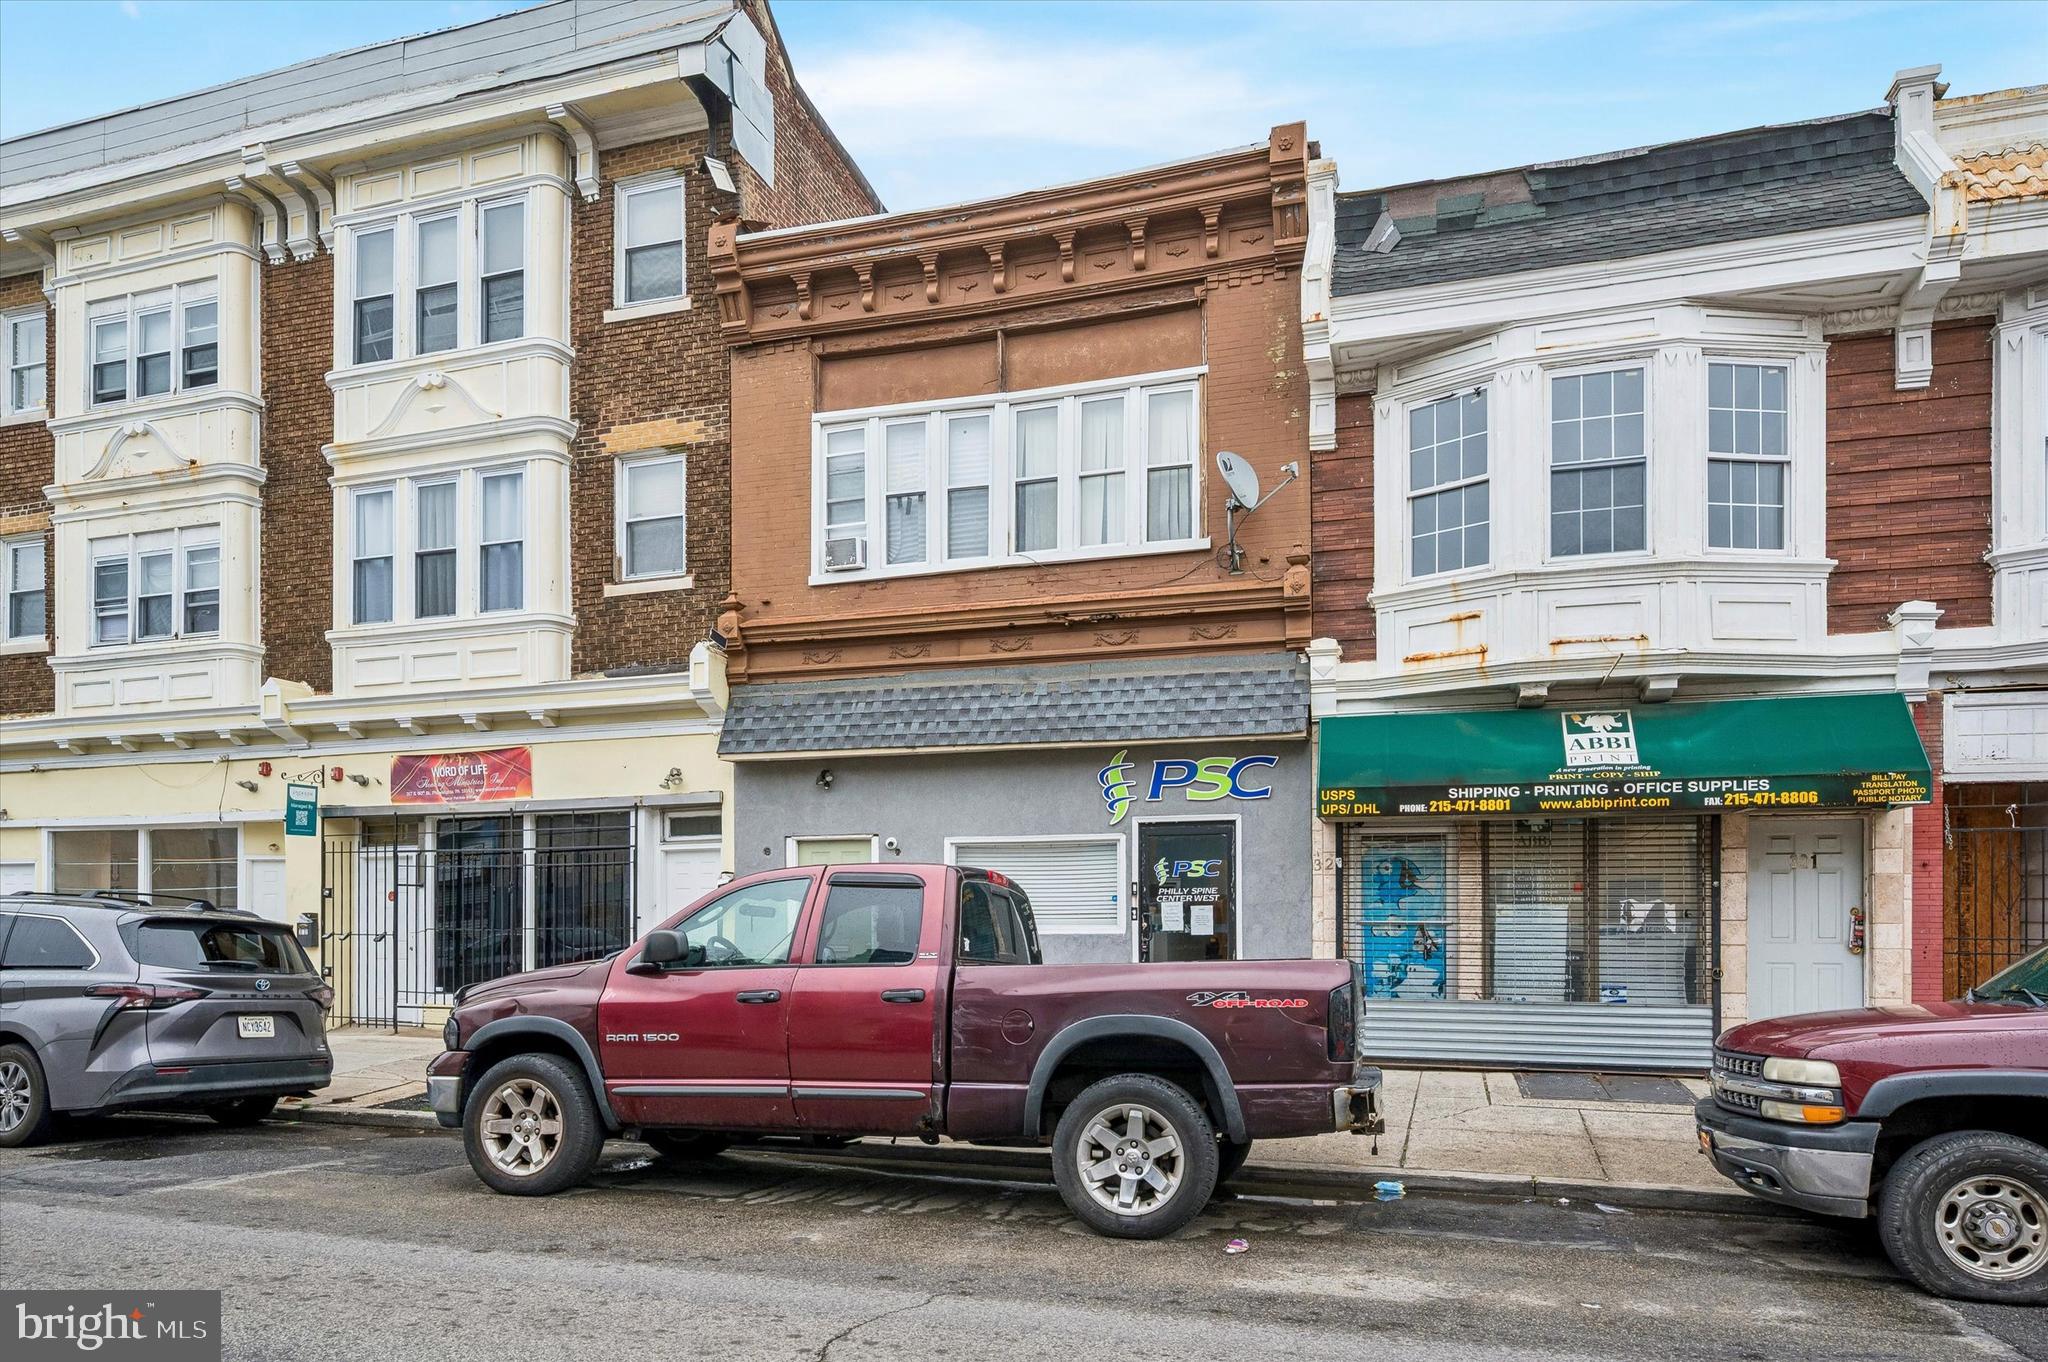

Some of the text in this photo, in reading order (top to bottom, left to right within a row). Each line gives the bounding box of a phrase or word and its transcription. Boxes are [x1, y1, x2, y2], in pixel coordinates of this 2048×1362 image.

[1569, 736, 1631, 751] ABBI
[1569, 754, 1637, 764] PRINT
[431, 764, 488, 778] WORD OF LIFE
[1578, 765, 1613, 773] generation
[1145, 755, 1279, 801] PSC
[1592, 771, 1625, 779] COPY
[1448, 786, 1521, 799] SHIPPING
[1534, 783, 1609, 797] PRINTING
[1623, 781, 1683, 795] OFFICE
[1687, 779, 1770, 793] SUPPLIES
[1861, 780, 1918, 788] TRANSLATION
[1321, 790, 1356, 801] USPS
[1853, 788, 1895, 796] PASSPORT
[1540, 796, 1670, 810] www.abbiprint.com
[1704, 791, 1818, 806] FAX: 215-471-8806
[1857, 794, 1922, 803] PUBLIC NOTARY
[1321, 803, 1381, 815] UPS/ DHL
[1400, 799, 1511, 813] PHONE: 215-471-8801
[1172, 859, 1222, 877] PSC
[1158, 887, 1219, 895] PHILLY SPINE
[1156, 894, 1220, 903] CENTER WEST
[1213, 999, 1309, 1009] OFF-ROAD
[606, 1033, 680, 1042] RAM 1500
